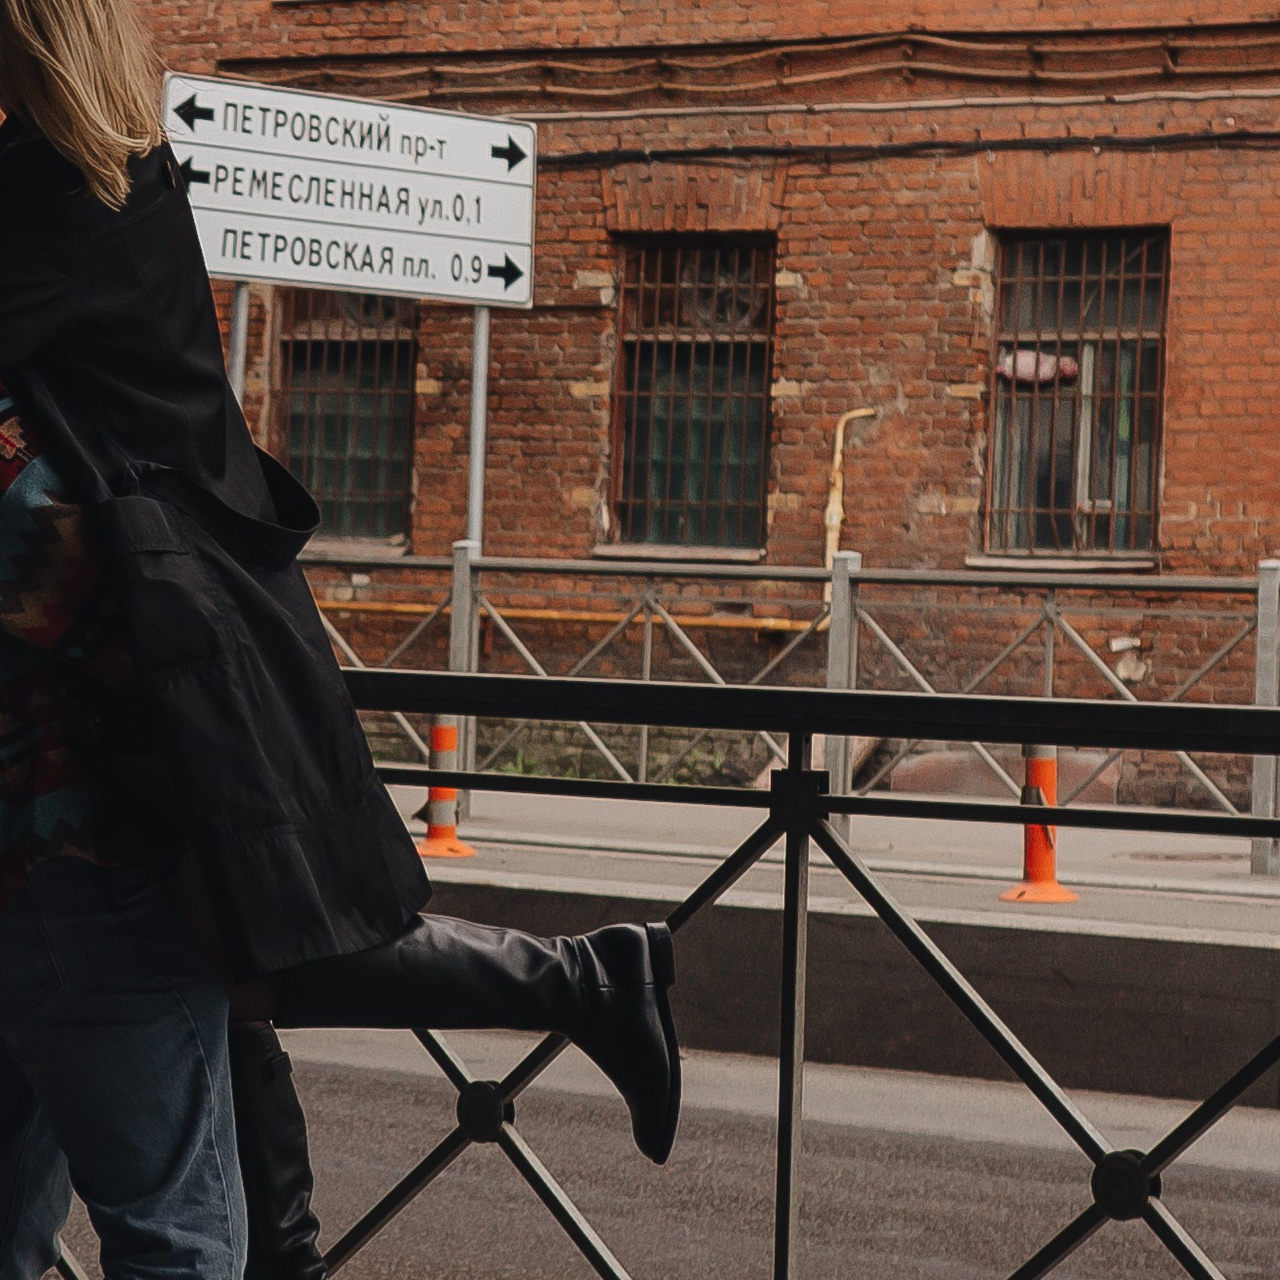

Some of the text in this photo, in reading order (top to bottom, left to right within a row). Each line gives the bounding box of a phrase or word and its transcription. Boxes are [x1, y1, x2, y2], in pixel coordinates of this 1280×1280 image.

[223, 102, 447, 164] ПЕТРОВСКИЙ пр-т
[213, 163, 410, 216] РЕМЕСЛЕННАЯ
[221, 228, 394, 275] ПЕТРОВСКАЯ
[402, 256, 436, 280] пл.
